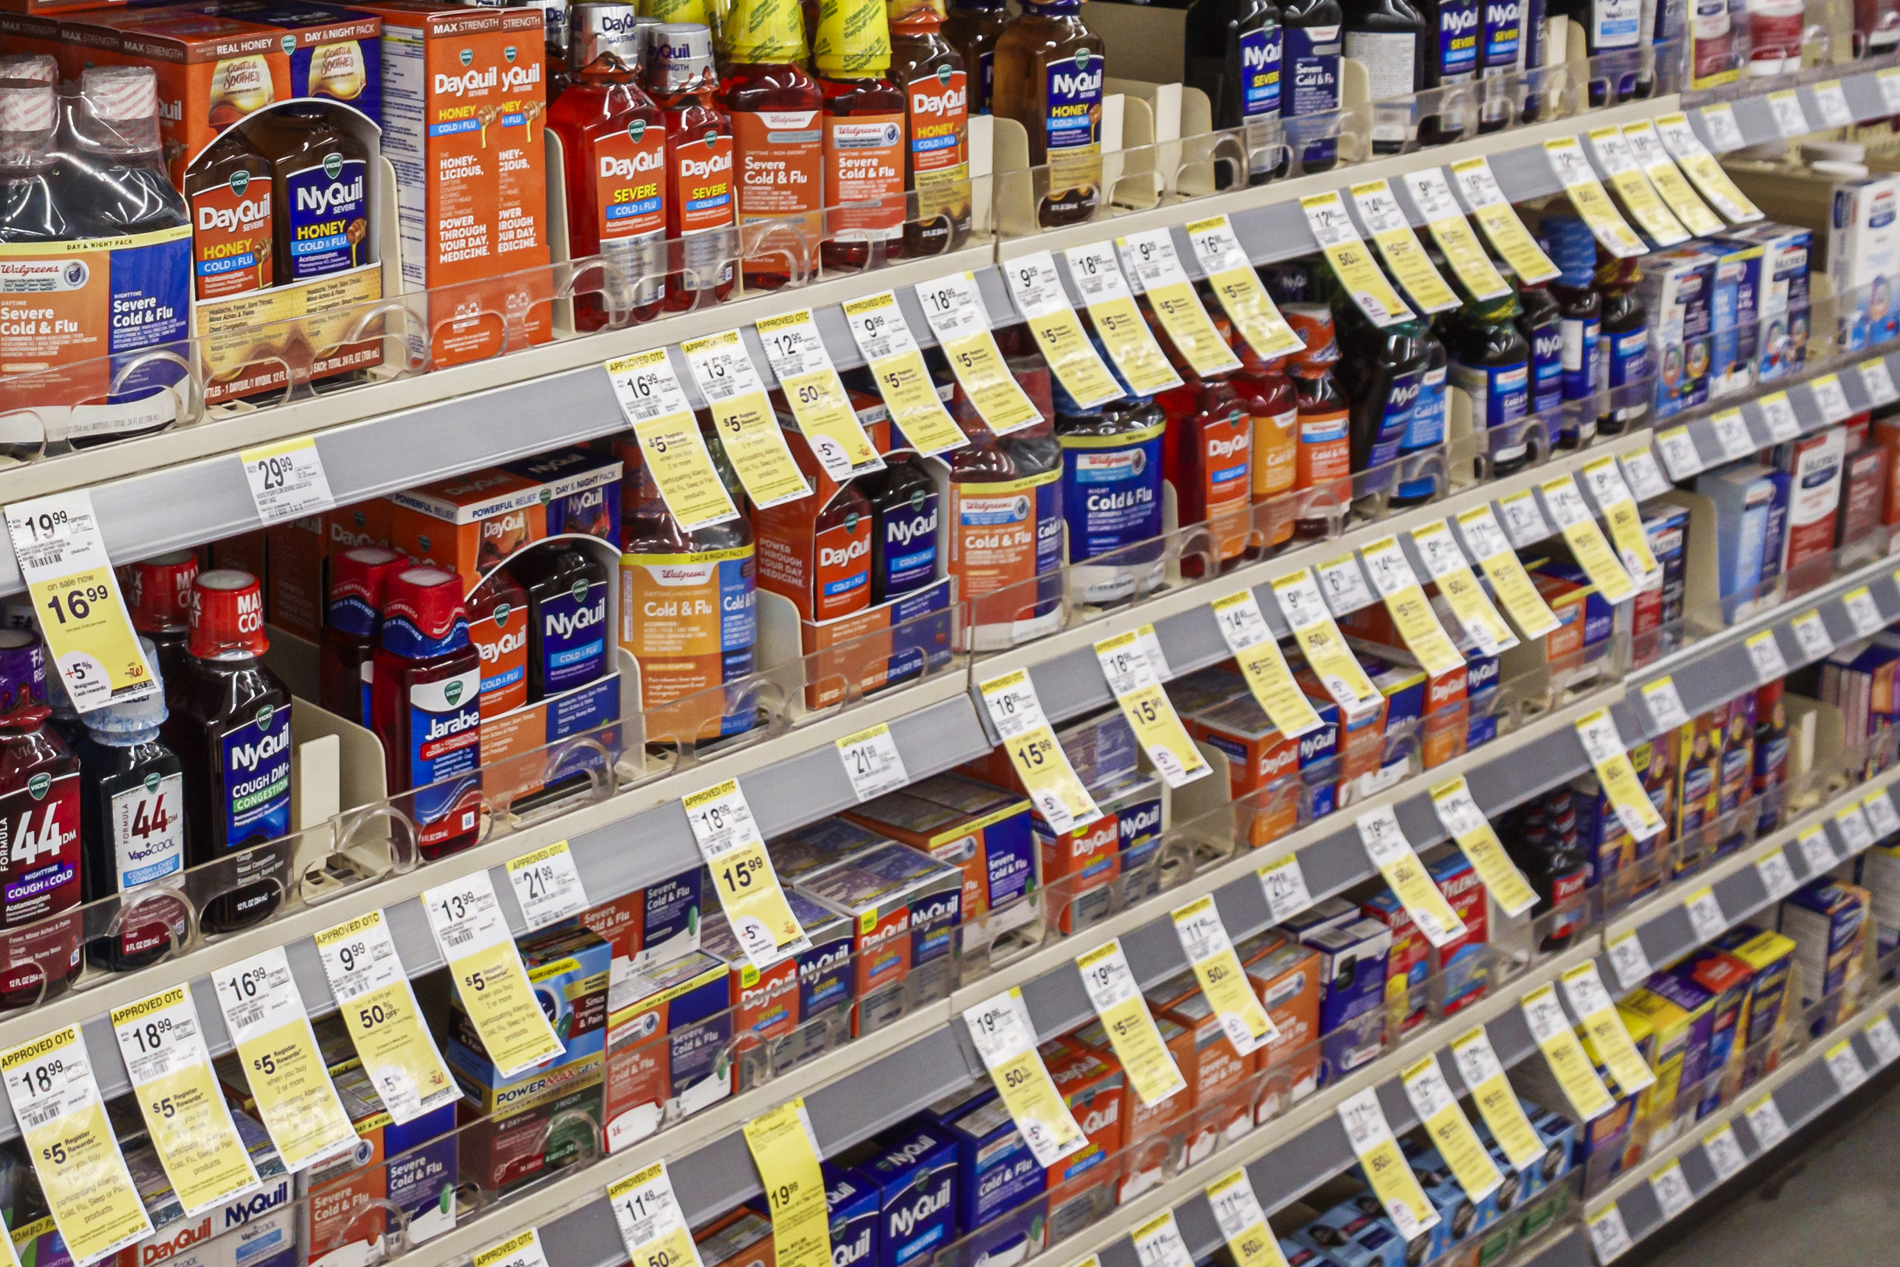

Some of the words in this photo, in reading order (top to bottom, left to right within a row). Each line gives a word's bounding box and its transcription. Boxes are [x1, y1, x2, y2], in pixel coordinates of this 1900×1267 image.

[217, 43, 236, 54] REAL
[240, 39, 273, 52] HONEY
[434, 69, 497, 97] DayQuil
[1053, 71, 1102, 98] NyQuil
[600, 148, 664, 178] DayQuil
[297, 178, 363, 213] NyQuil
[199, 196, 270, 233] DayQuil
[297, 221, 346, 239] HONEY
[888, 509, 937, 545] NyQuil
[546, 597, 605, 639] NyQuil
[644, 601, 677, 617] Cold
[681, 601, 692, 616] &
[695, 600, 712, 615] Flu
[425, 710, 479, 738] Jarabe
[232, 730, 288, 770] NyQuil
[890, 1175, 952, 1237] NyQuil
